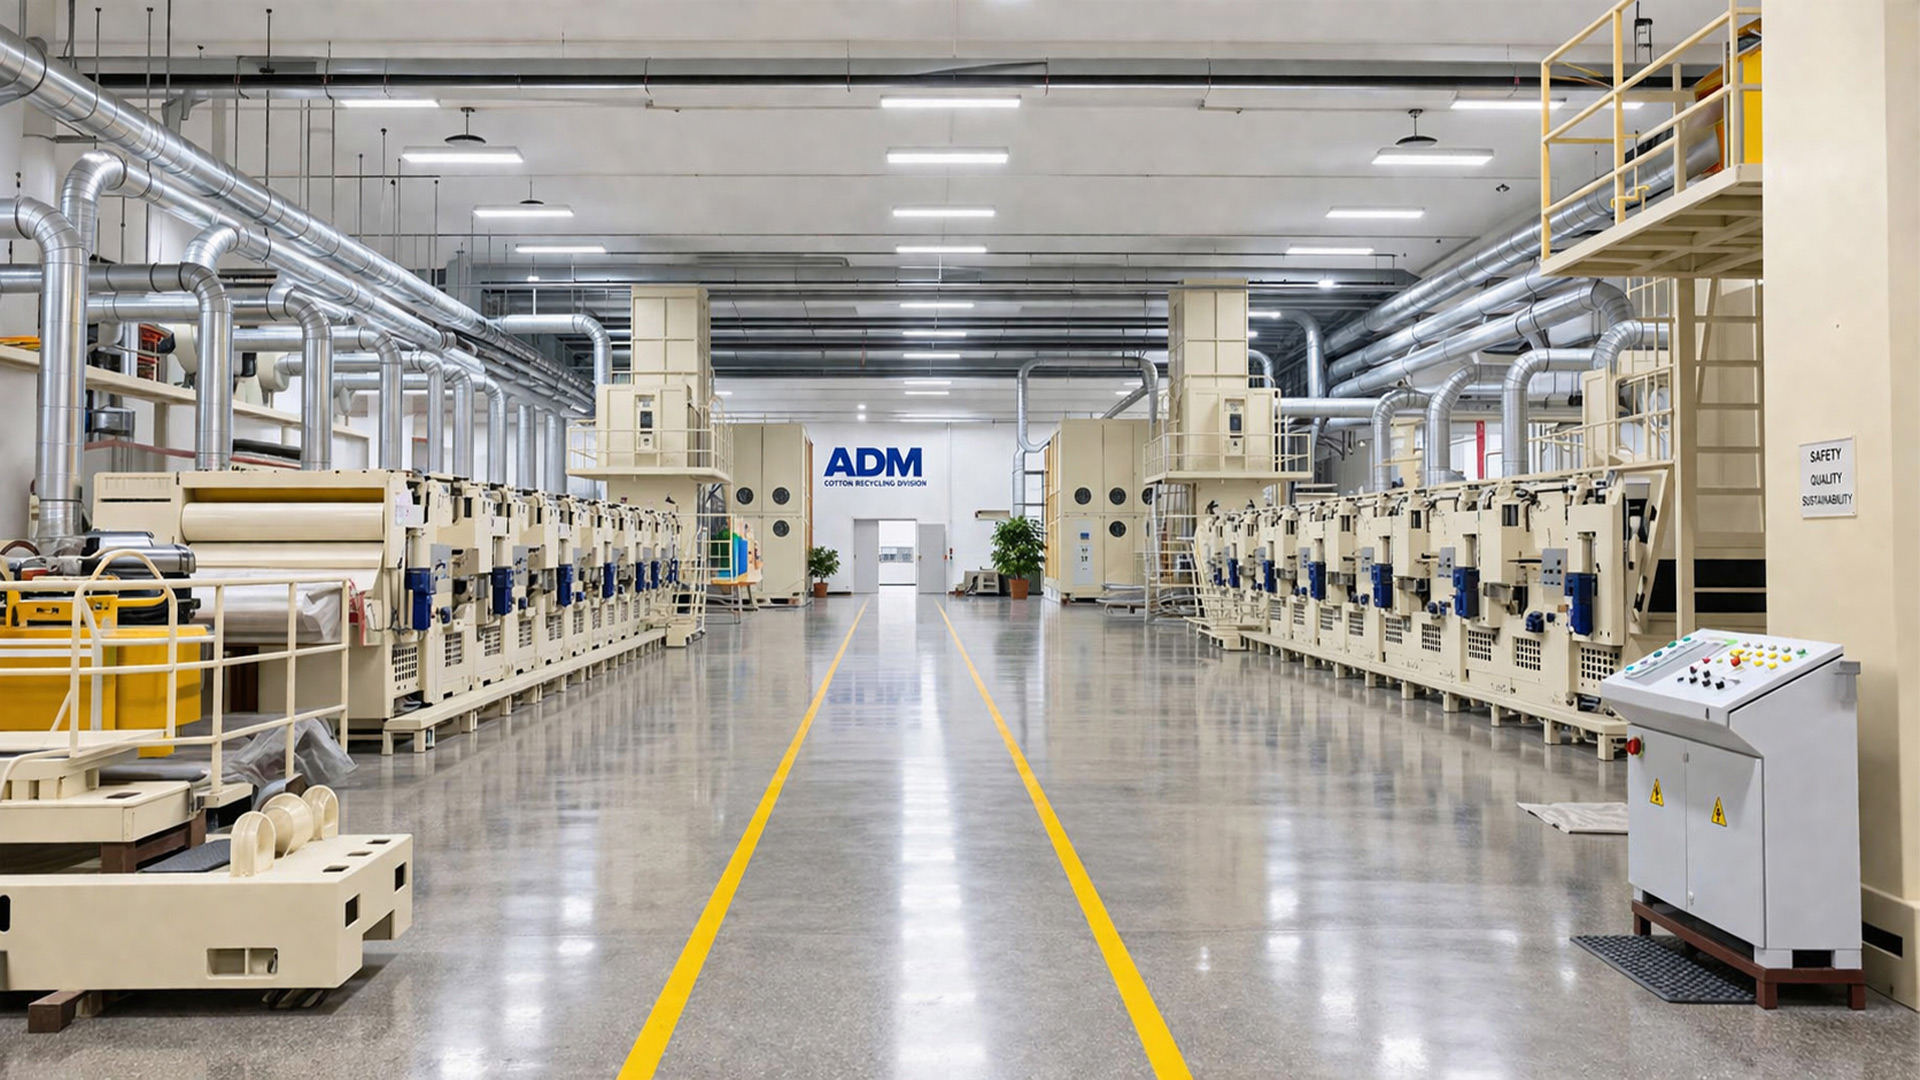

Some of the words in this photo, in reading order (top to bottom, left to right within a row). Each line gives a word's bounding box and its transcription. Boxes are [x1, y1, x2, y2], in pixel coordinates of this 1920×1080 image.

[824, 447, 922, 477] ADM
[1810, 448, 1842, 463] SAFETY
[1810, 472, 1842, 486] QUALITY
